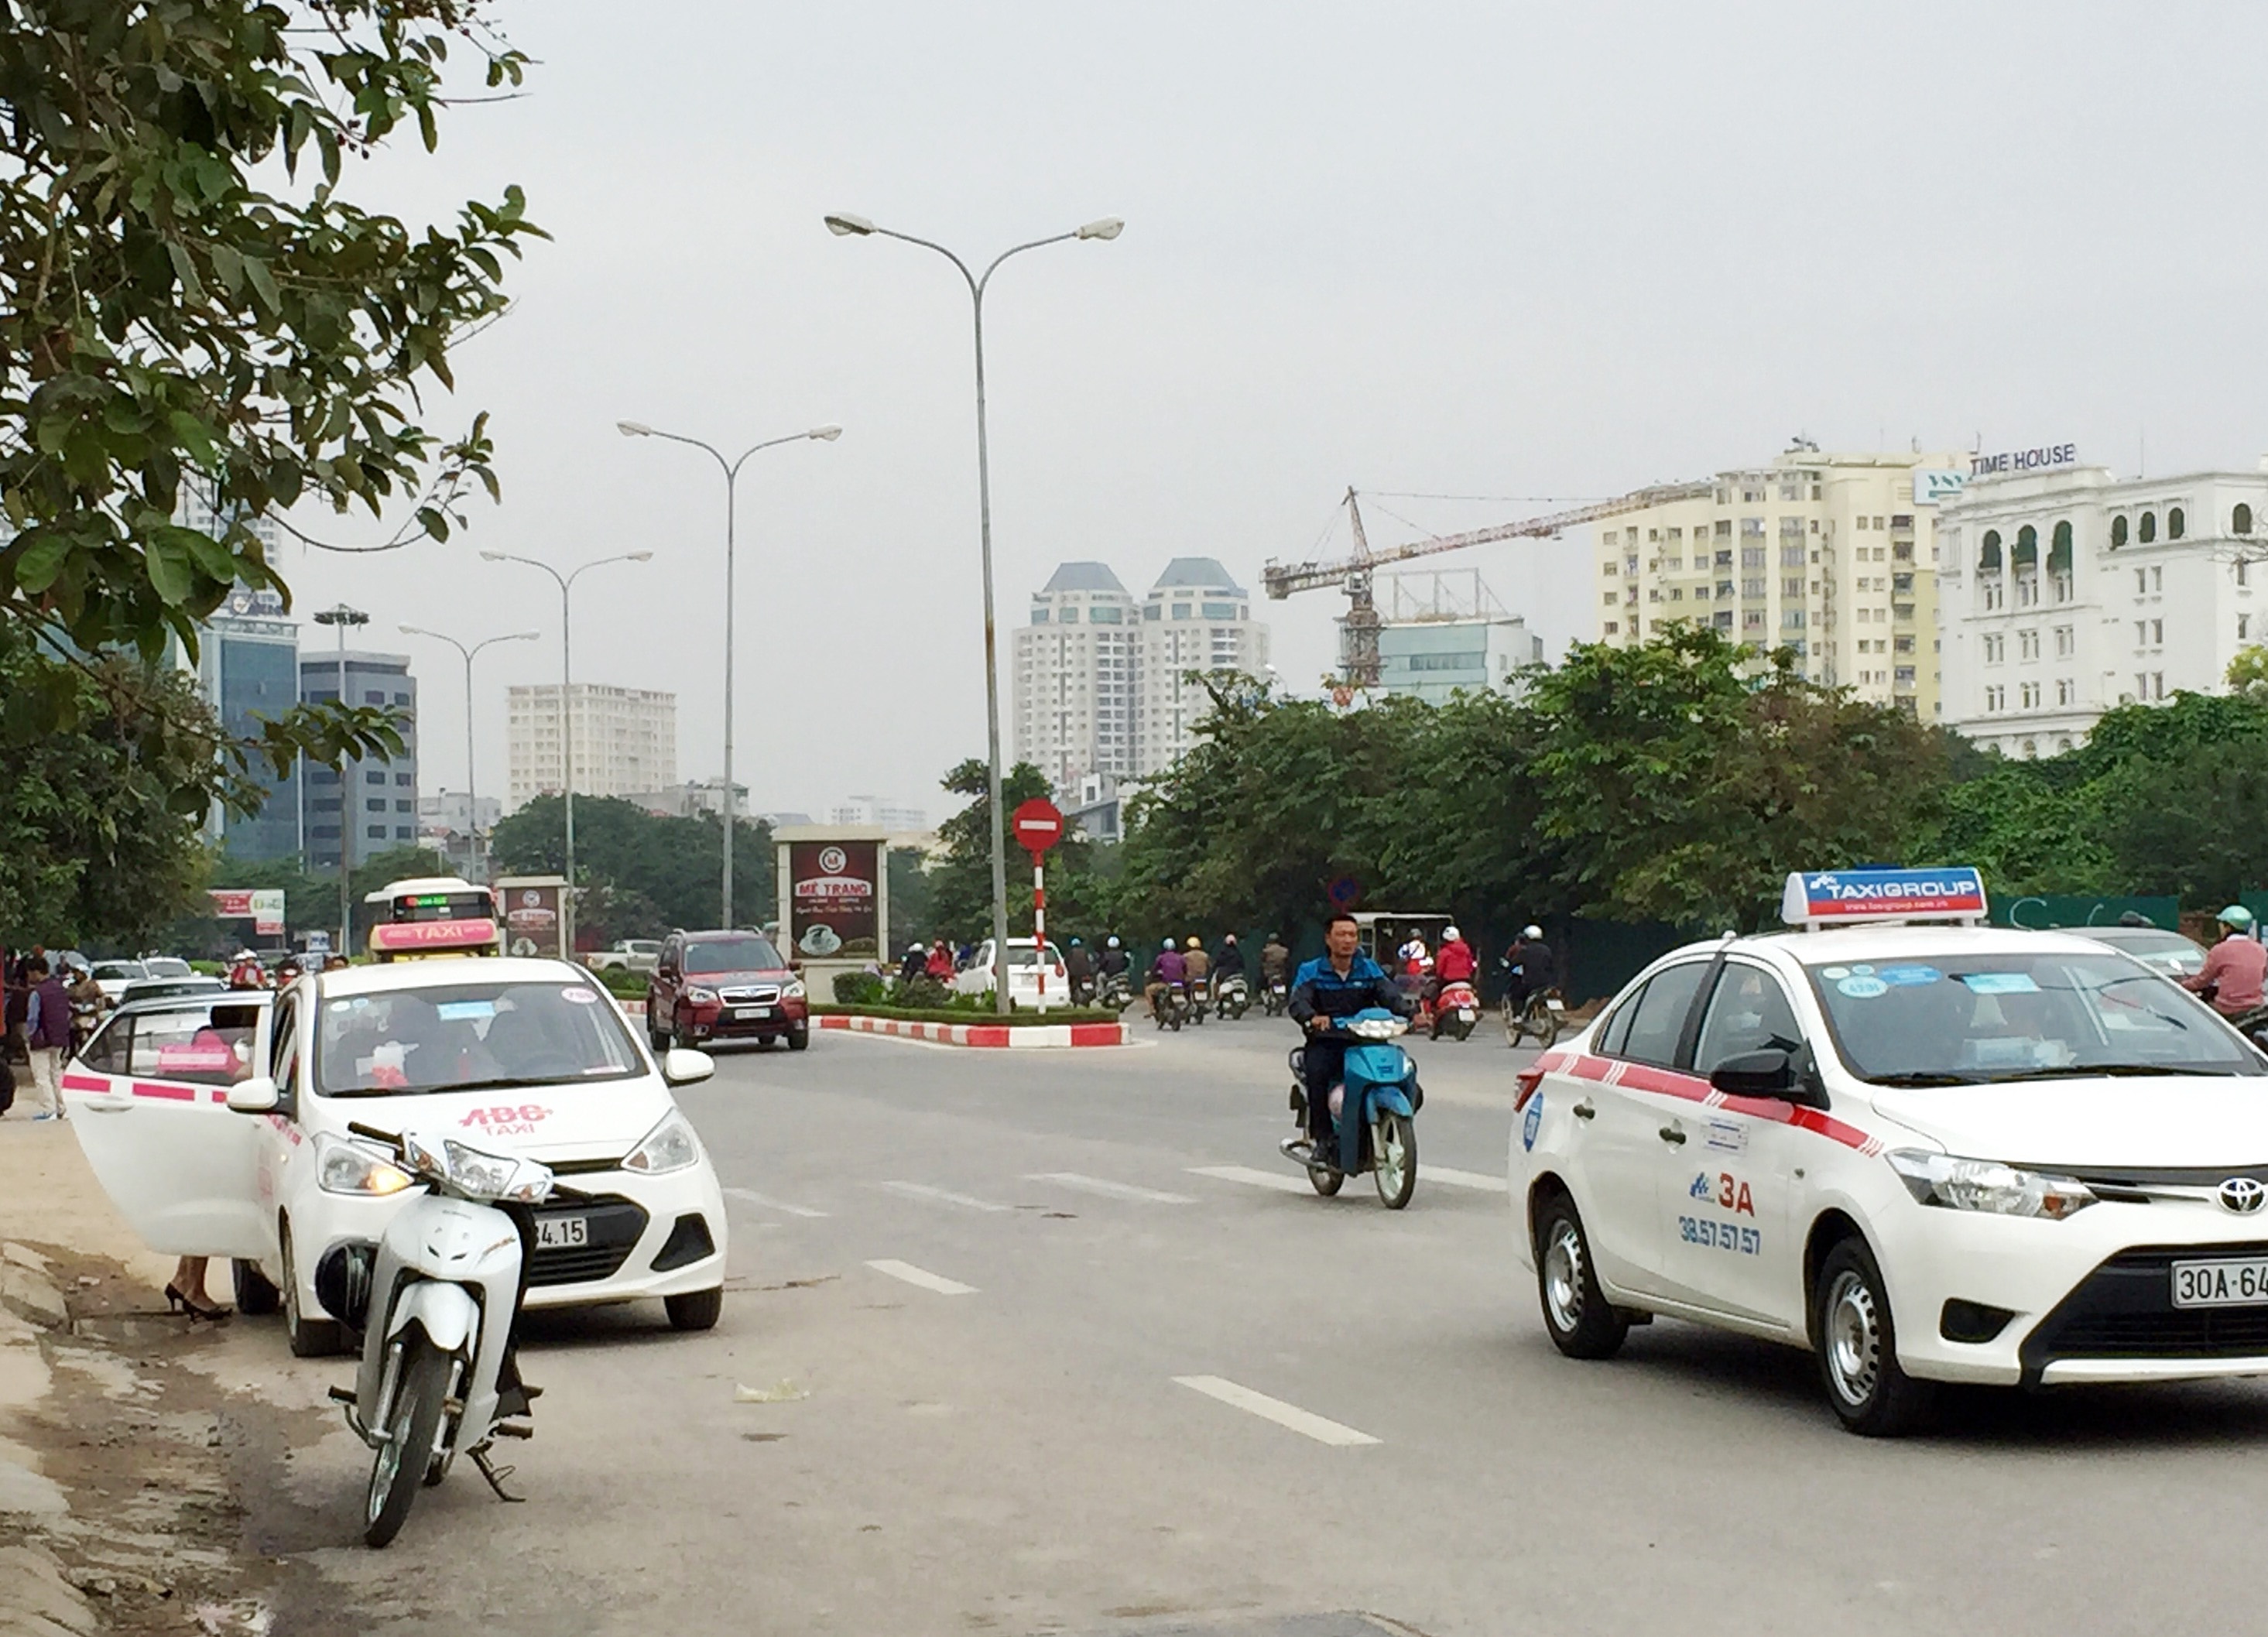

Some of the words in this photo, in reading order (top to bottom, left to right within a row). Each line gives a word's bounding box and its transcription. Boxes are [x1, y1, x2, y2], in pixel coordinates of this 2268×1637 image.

[1970, 454, 2008, 476] TIME
[2014, 443, 2075, 470] HOUSE
[1827, 881, 1975, 899] TAXIGROUP
[412, 925, 463, 940] TAXI
[480, 1123, 535, 1136] TAXI
[1718, 1172, 1755, 1217] 3A
[535, 1220, 584, 1244] 4.15
